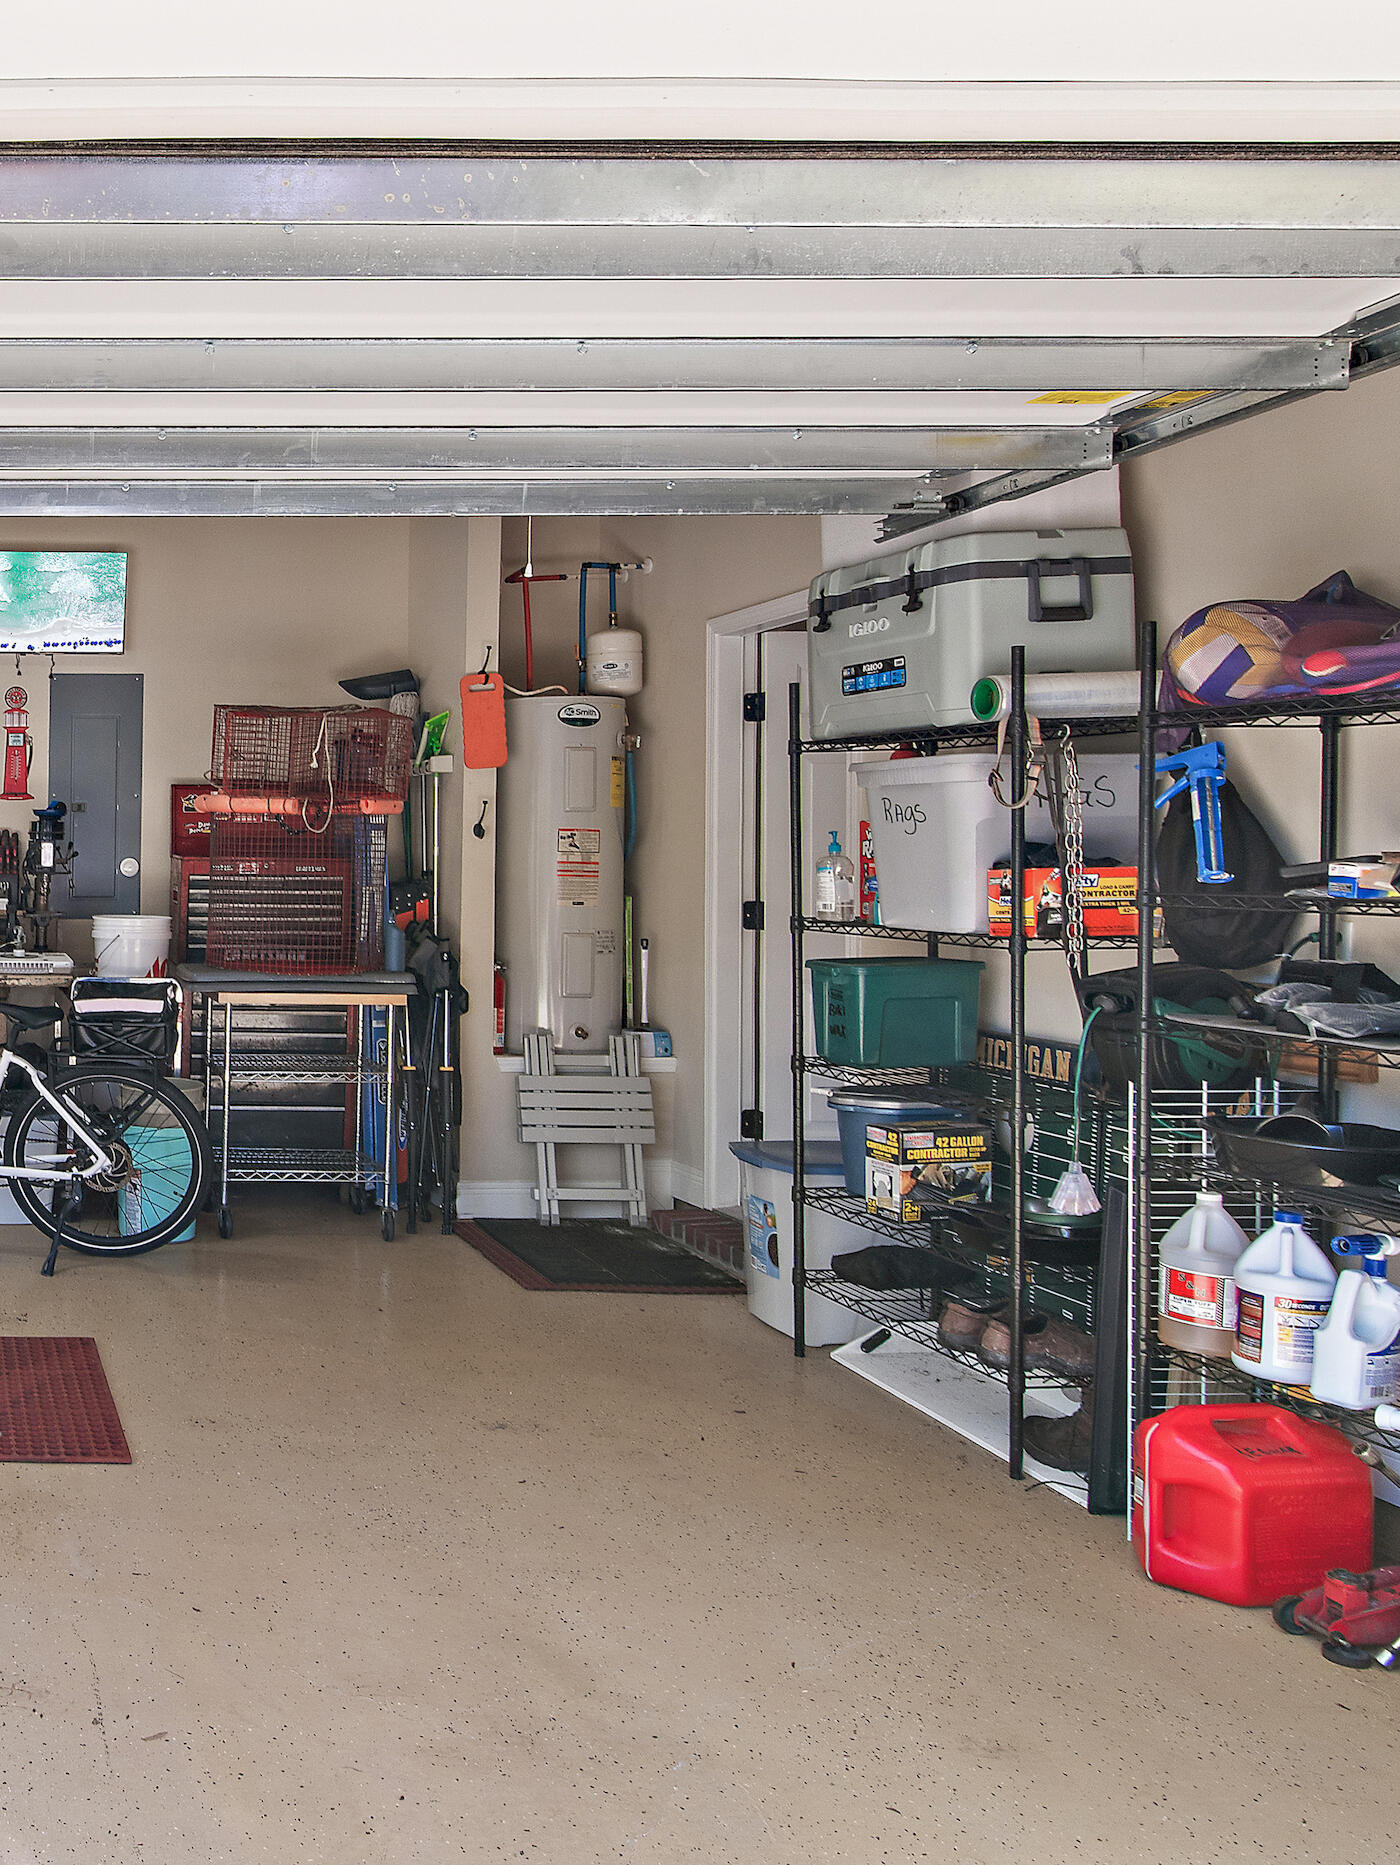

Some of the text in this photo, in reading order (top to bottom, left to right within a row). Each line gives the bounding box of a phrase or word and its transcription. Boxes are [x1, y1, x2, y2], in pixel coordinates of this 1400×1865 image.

[848, 616, 891, 639] IGLOO
[862, 661, 884, 673] IGLOO
[575, 708, 598, 717] Smith
[1077, 889, 1135, 898] ONTRACTOR
[935, 1135, 984, 1147] 42 GALLON
[906, 1148, 968, 1160] CONTRACTOR
[904, 1202, 919, 1213] 24
[1173, 1295, 1192, 1304] SUPER
[1278, 1298, 1292, 1309] 30
